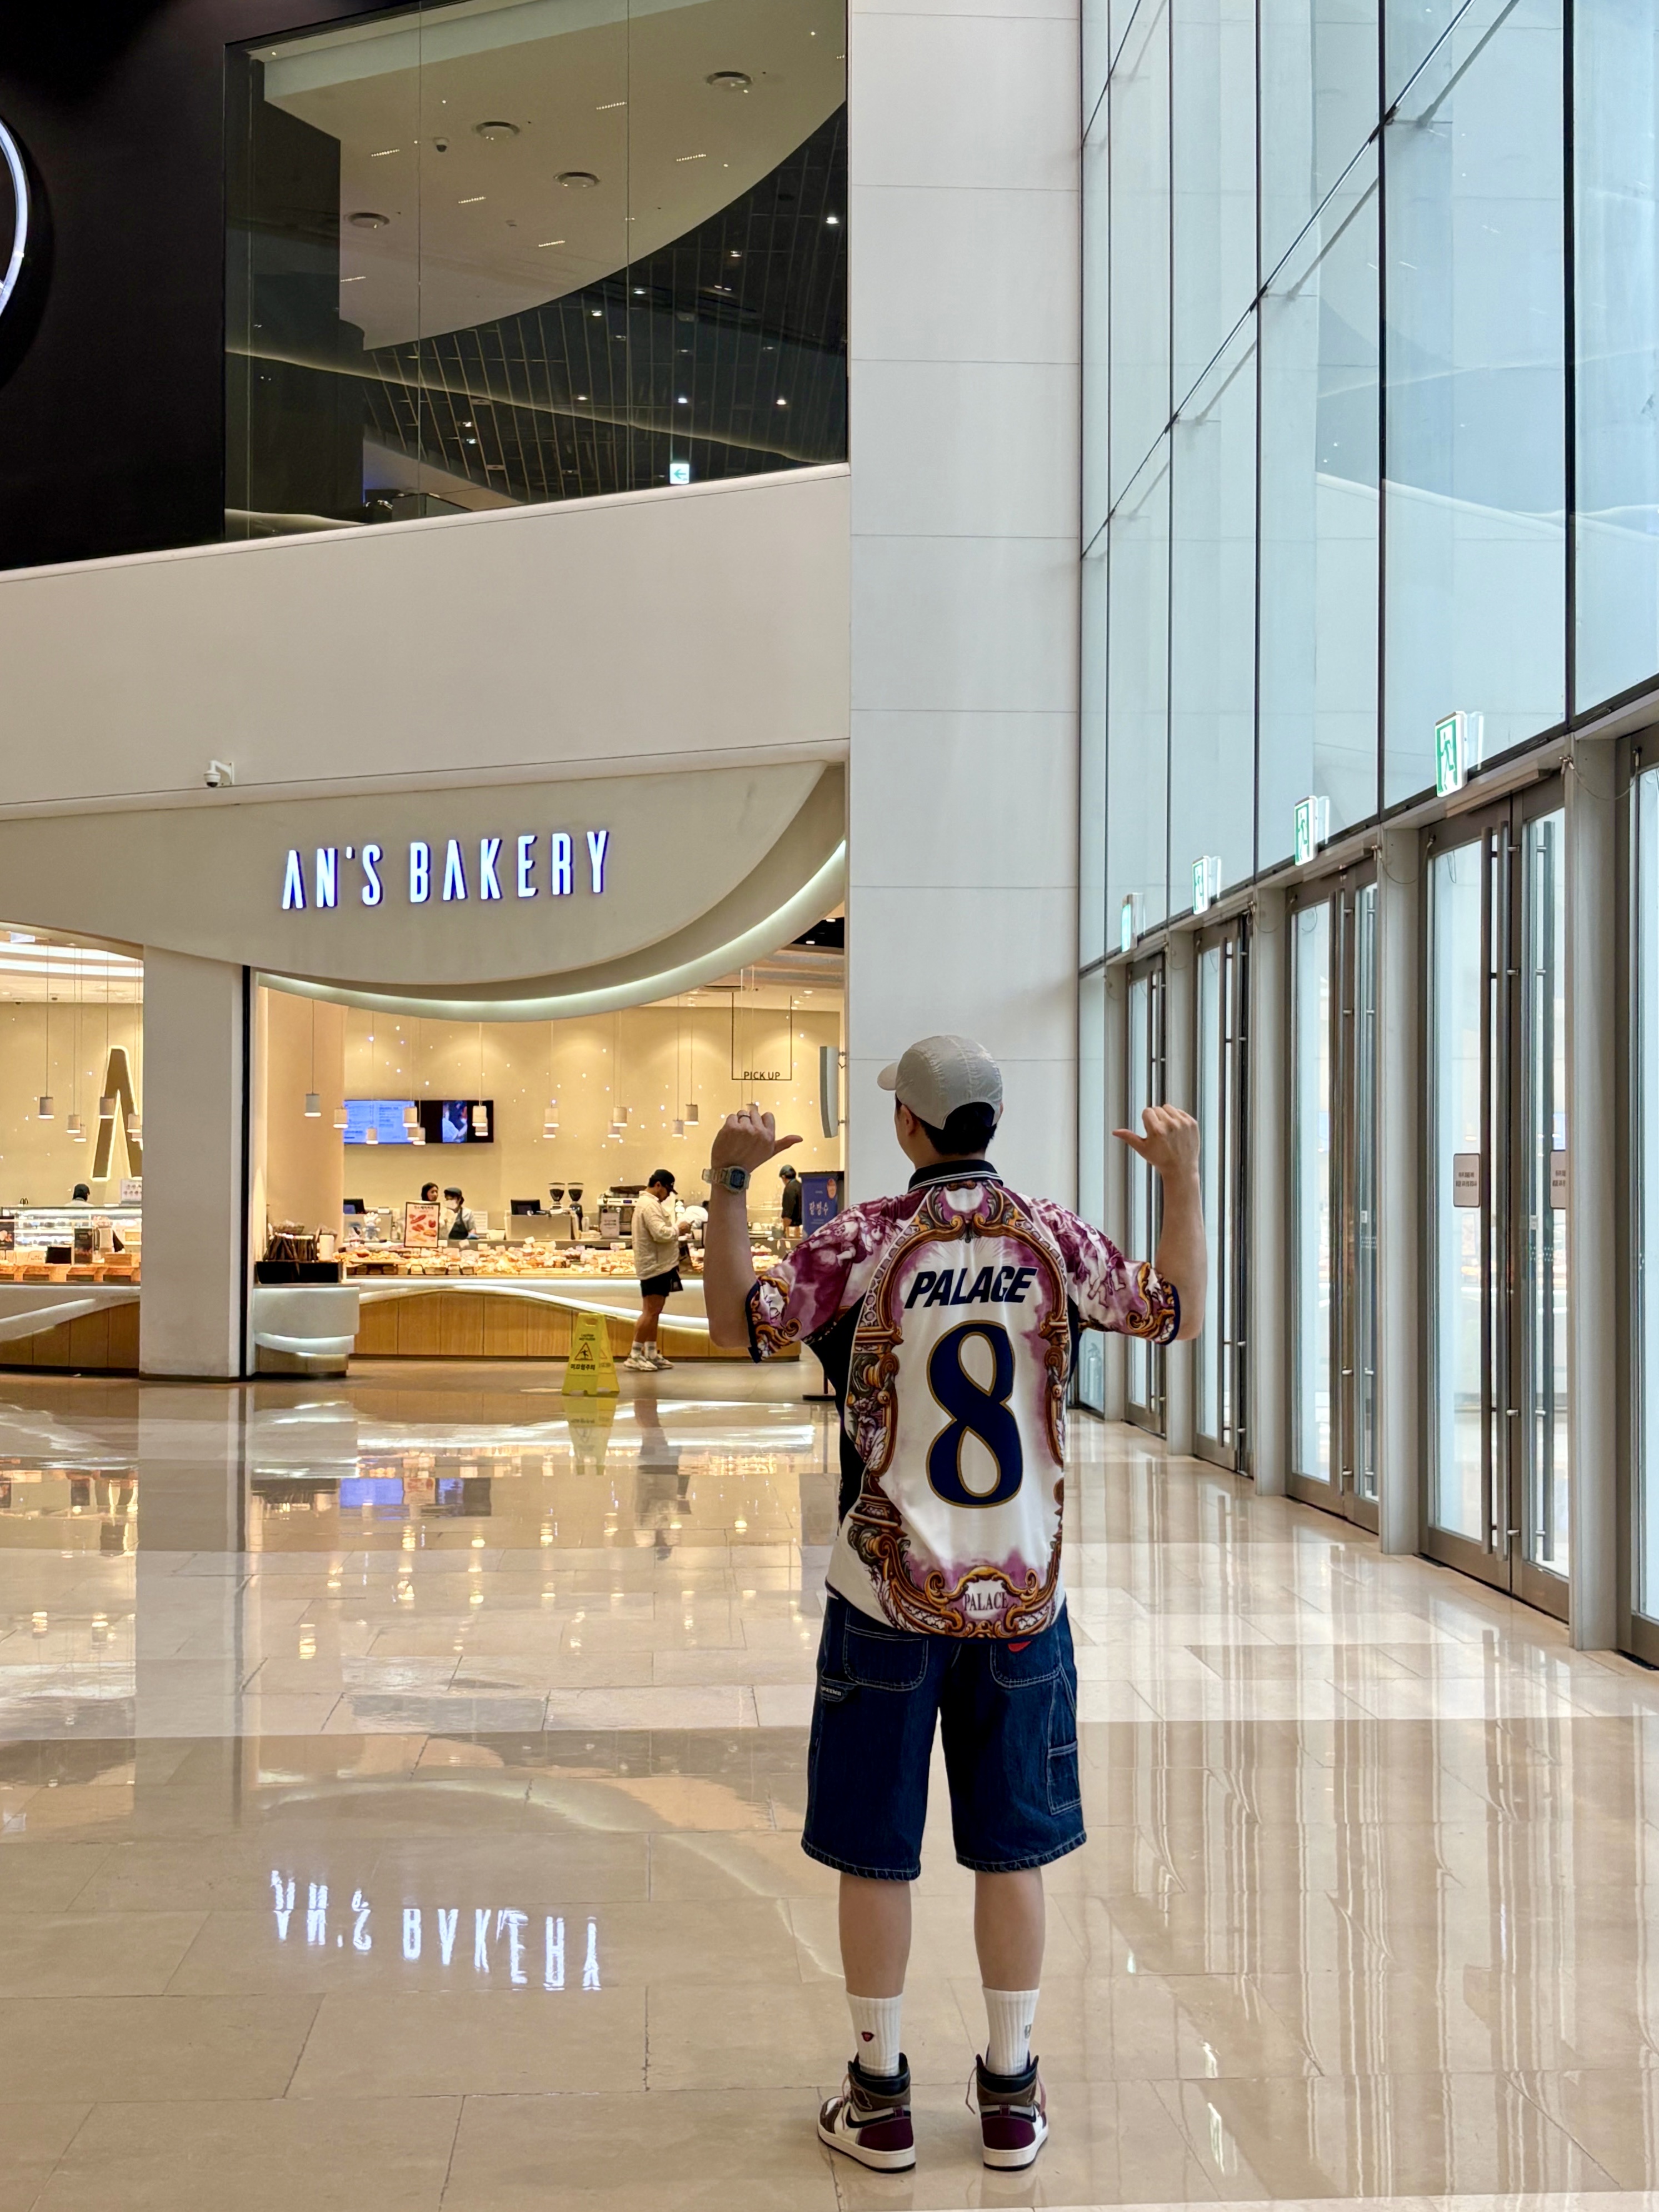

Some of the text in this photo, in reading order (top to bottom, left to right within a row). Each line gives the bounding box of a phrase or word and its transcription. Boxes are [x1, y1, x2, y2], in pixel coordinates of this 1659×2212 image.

[282, 830, 608, 910] AN'S BAKERY
[743, 1071, 780, 1080] PICK UP
[904, 1265, 1038, 1309] PALACE
[926, 1320, 1023, 1509] 8
[965, 1591, 1008, 1611] PALACE
